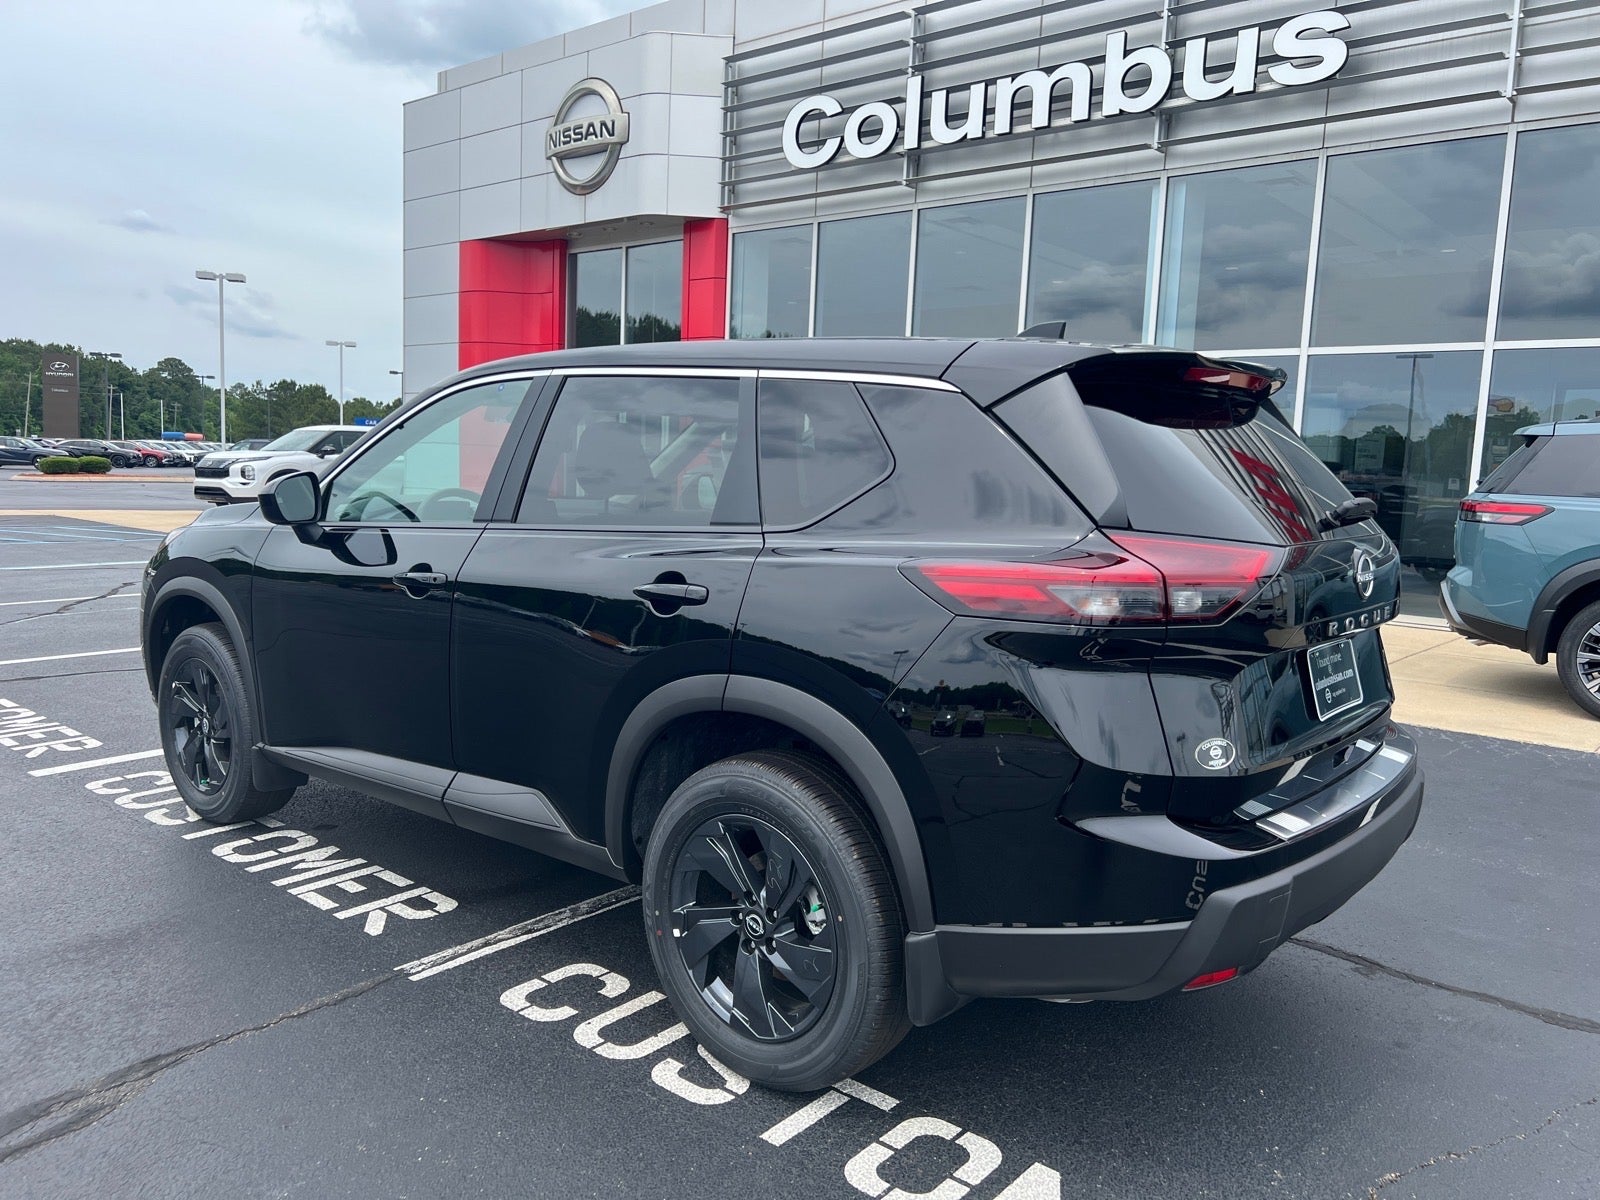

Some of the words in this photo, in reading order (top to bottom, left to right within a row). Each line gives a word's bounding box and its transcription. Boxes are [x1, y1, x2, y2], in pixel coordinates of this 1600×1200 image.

[781, 10, 1352, 170] Columbus
[548, 119, 616, 151] NISSAN
[1327, 605, 1391, 637] ROGUE
[1201, 740, 1227, 751] COLUMBUS
